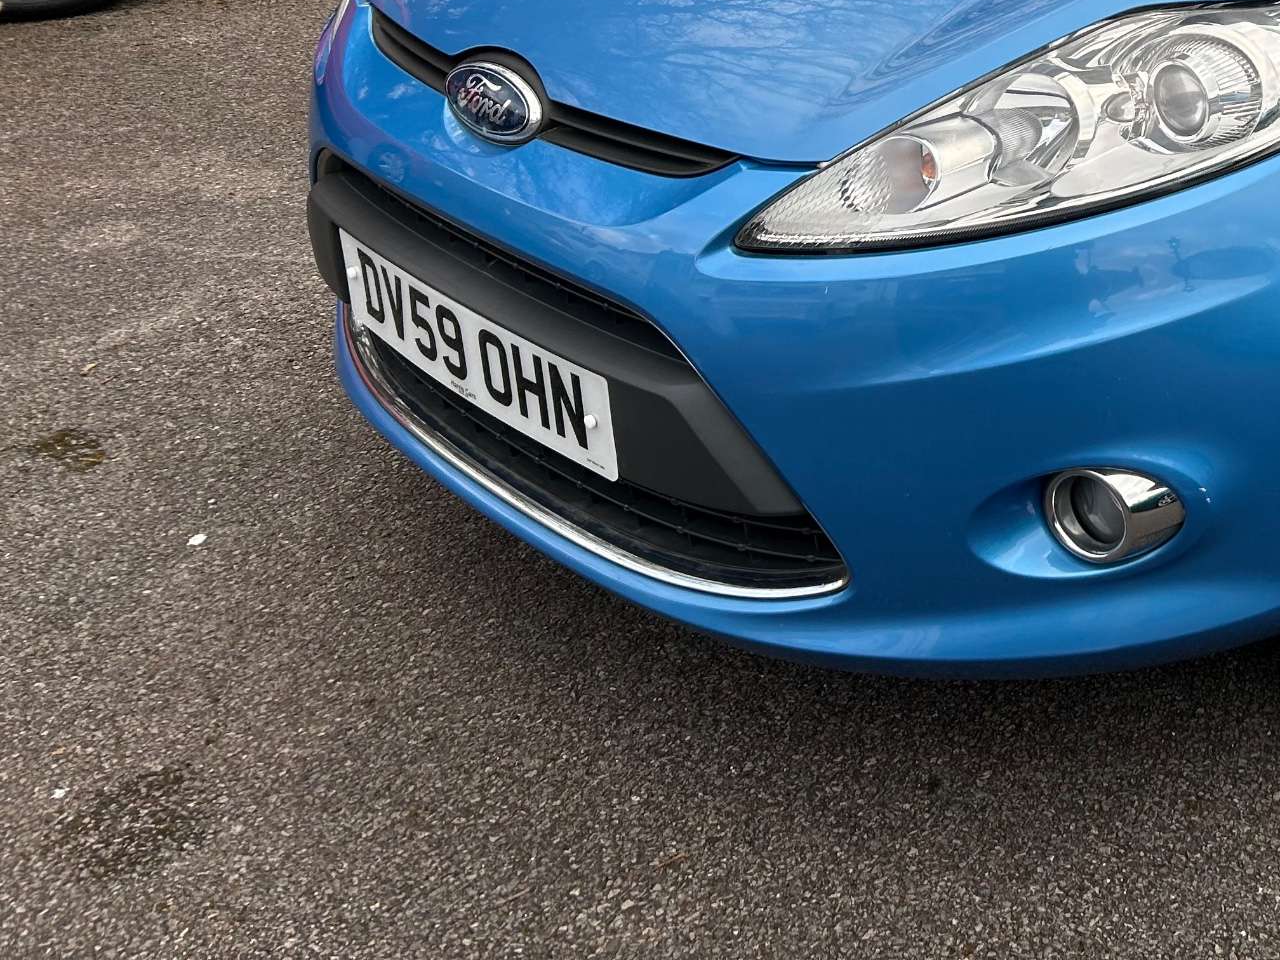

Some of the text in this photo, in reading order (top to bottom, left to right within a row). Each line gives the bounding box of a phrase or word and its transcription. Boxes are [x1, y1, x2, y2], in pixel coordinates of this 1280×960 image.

[457, 73, 512, 123] Ford
[356, 247, 589, 451] DV59 OHN
